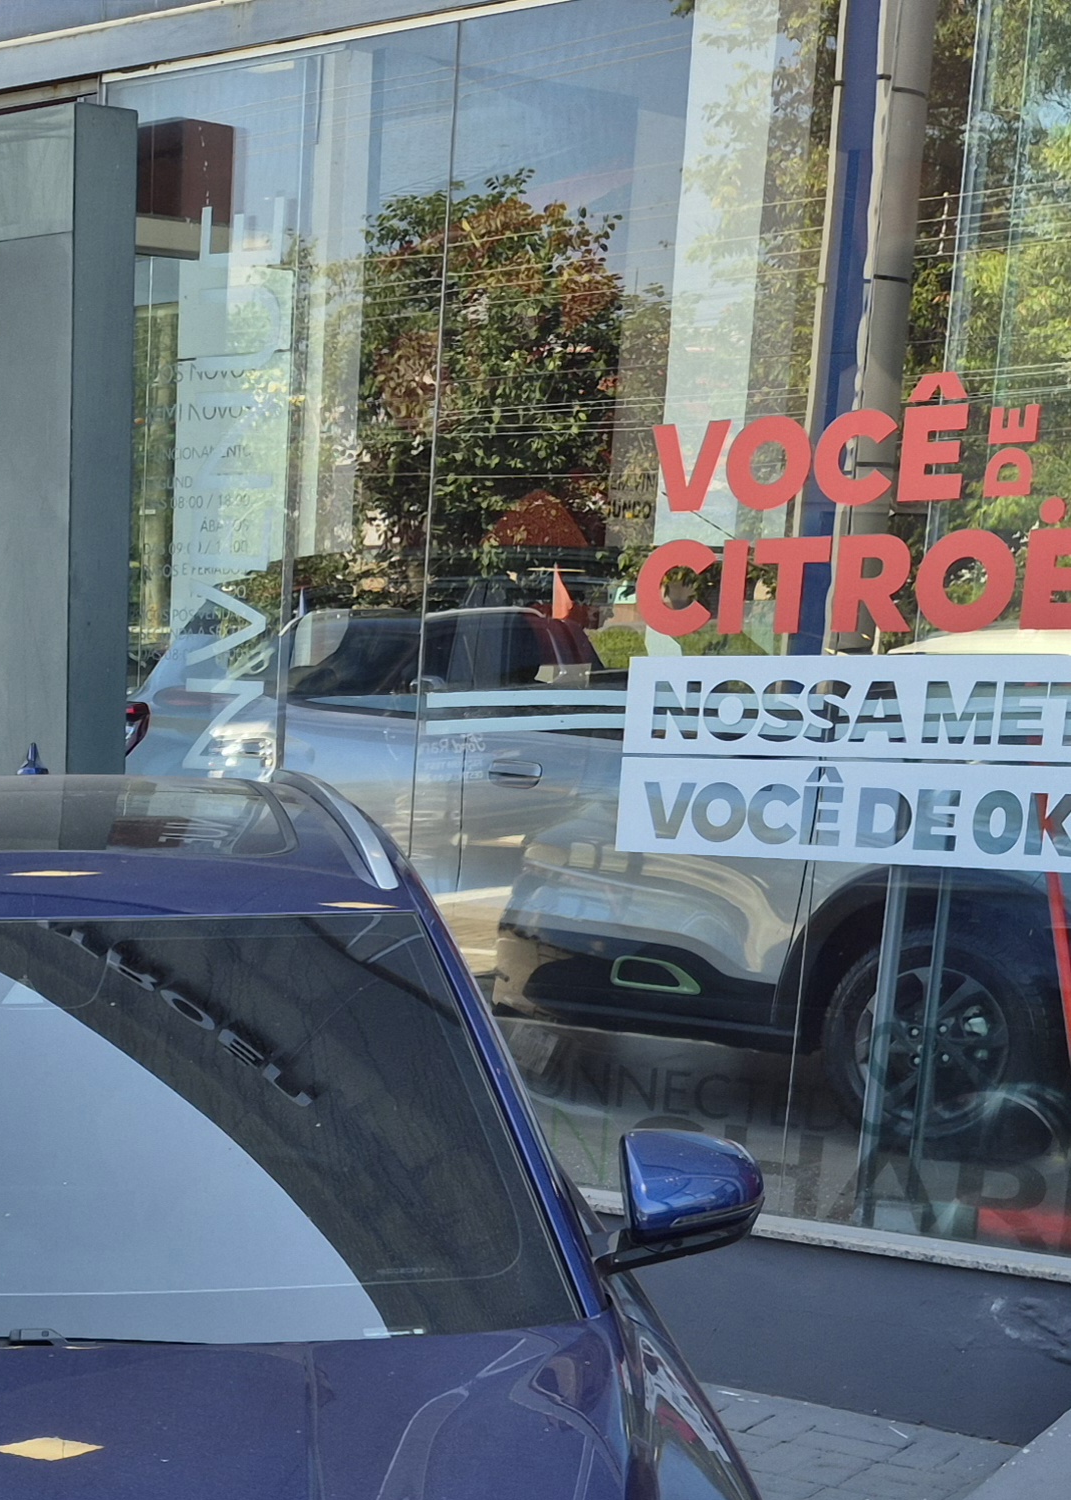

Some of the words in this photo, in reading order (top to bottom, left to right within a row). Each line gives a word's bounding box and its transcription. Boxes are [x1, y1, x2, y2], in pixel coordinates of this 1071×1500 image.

[652, 371, 969, 512] VOCÊ
[983, 404, 1040, 497] DE
[651, 680, 905, 743] NOSSA
[644, 766, 841, 846] VOCÊ
[856, 787, 961, 852] DE
